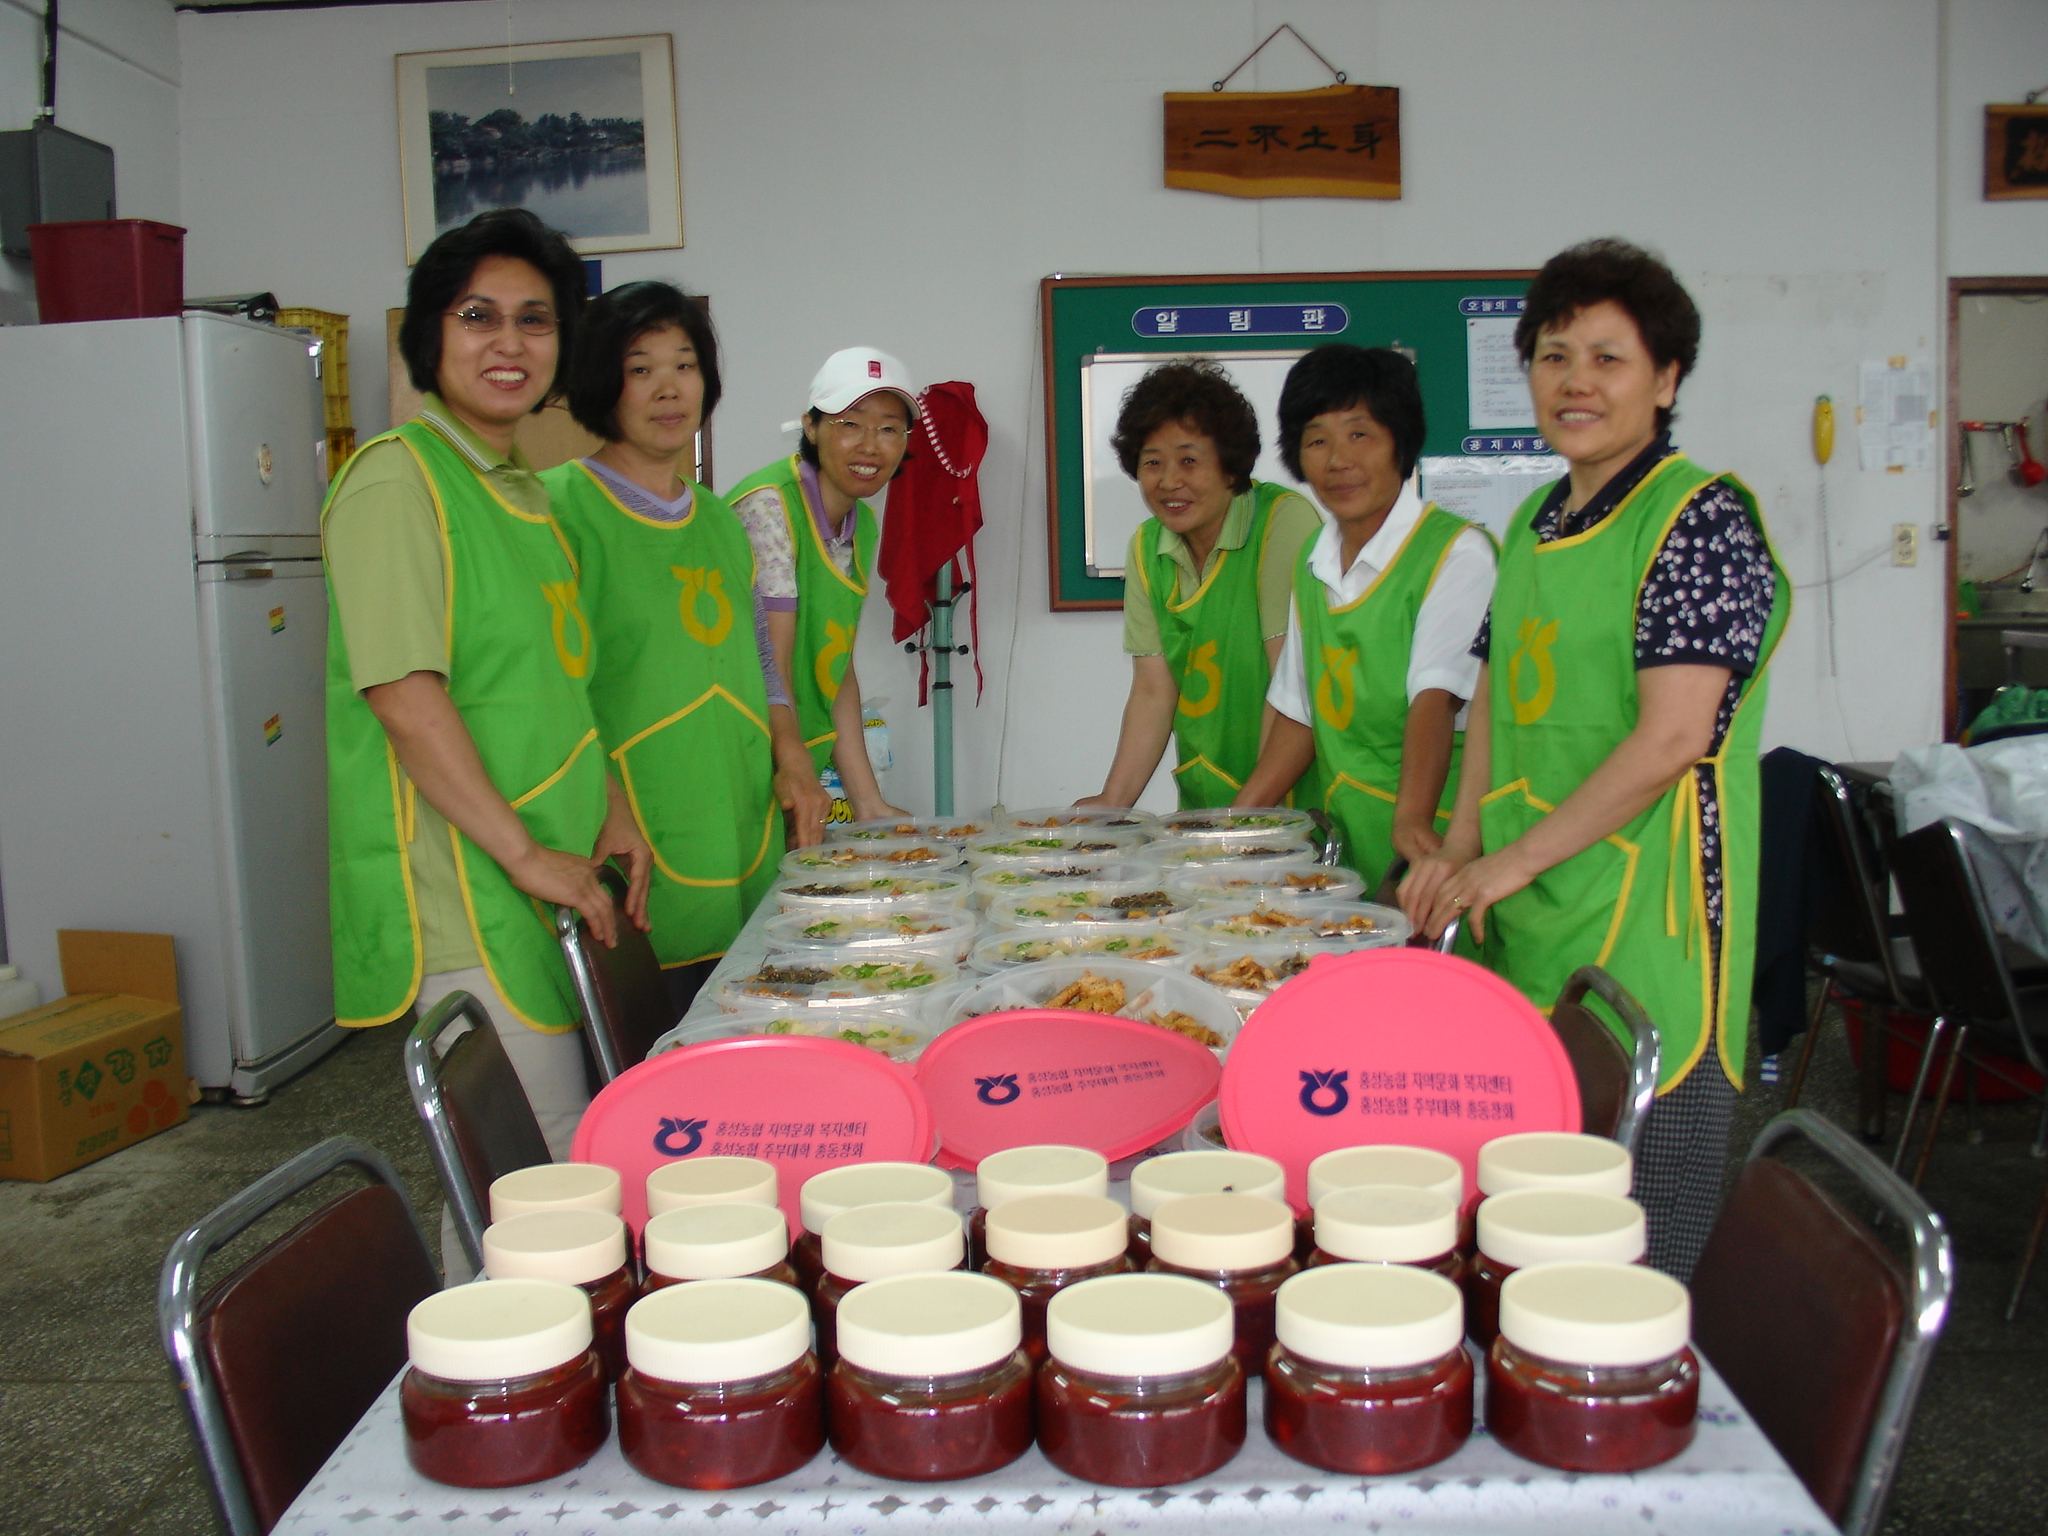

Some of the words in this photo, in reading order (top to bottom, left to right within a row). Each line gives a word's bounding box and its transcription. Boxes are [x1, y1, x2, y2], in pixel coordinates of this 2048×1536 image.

[1467, 300, 1506, 312] 오늘의
[1359, 1071, 1406, 1090] 홍성농협
[1412, 1072, 1459, 1093] 지역문화
[1464, 1074, 1513, 1094] 복지센터
[1360, 1096, 1409, 1116] 홍성농협
[1413, 1098, 1461, 1118] 주부대학
[1467, 1099, 1515, 1121] 총동창회
[715, 1122, 764, 1138] 홍성농협
[768, 1122, 815, 1138] 지역문화
[819, 1122, 867, 1138] 복지센터
[710, 1142, 759, 1157] 홍성농협
[763, 1143, 811, 1159] 주부대학
[815, 1142, 864, 1160] 총동창회
